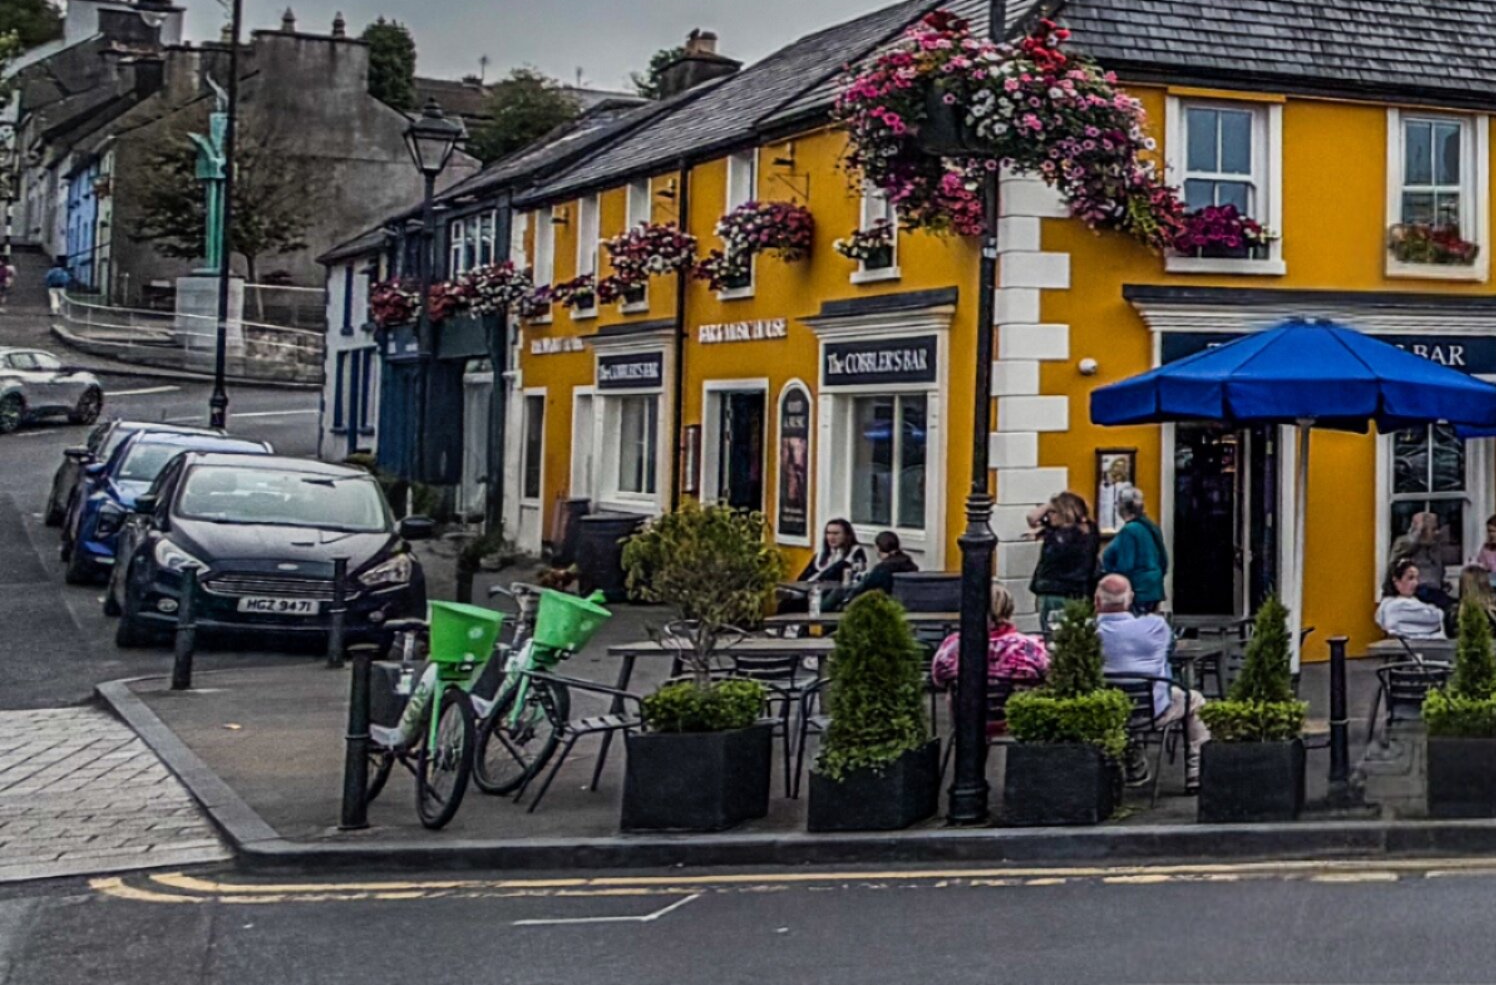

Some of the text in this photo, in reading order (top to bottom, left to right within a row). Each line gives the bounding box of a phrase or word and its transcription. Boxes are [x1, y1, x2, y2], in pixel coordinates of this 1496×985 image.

[827, 348, 929, 375] The COBBLER'S BAR
[1412, 344, 1467, 366] BAR
[246, 599, 312, 612] HGZ 9471
